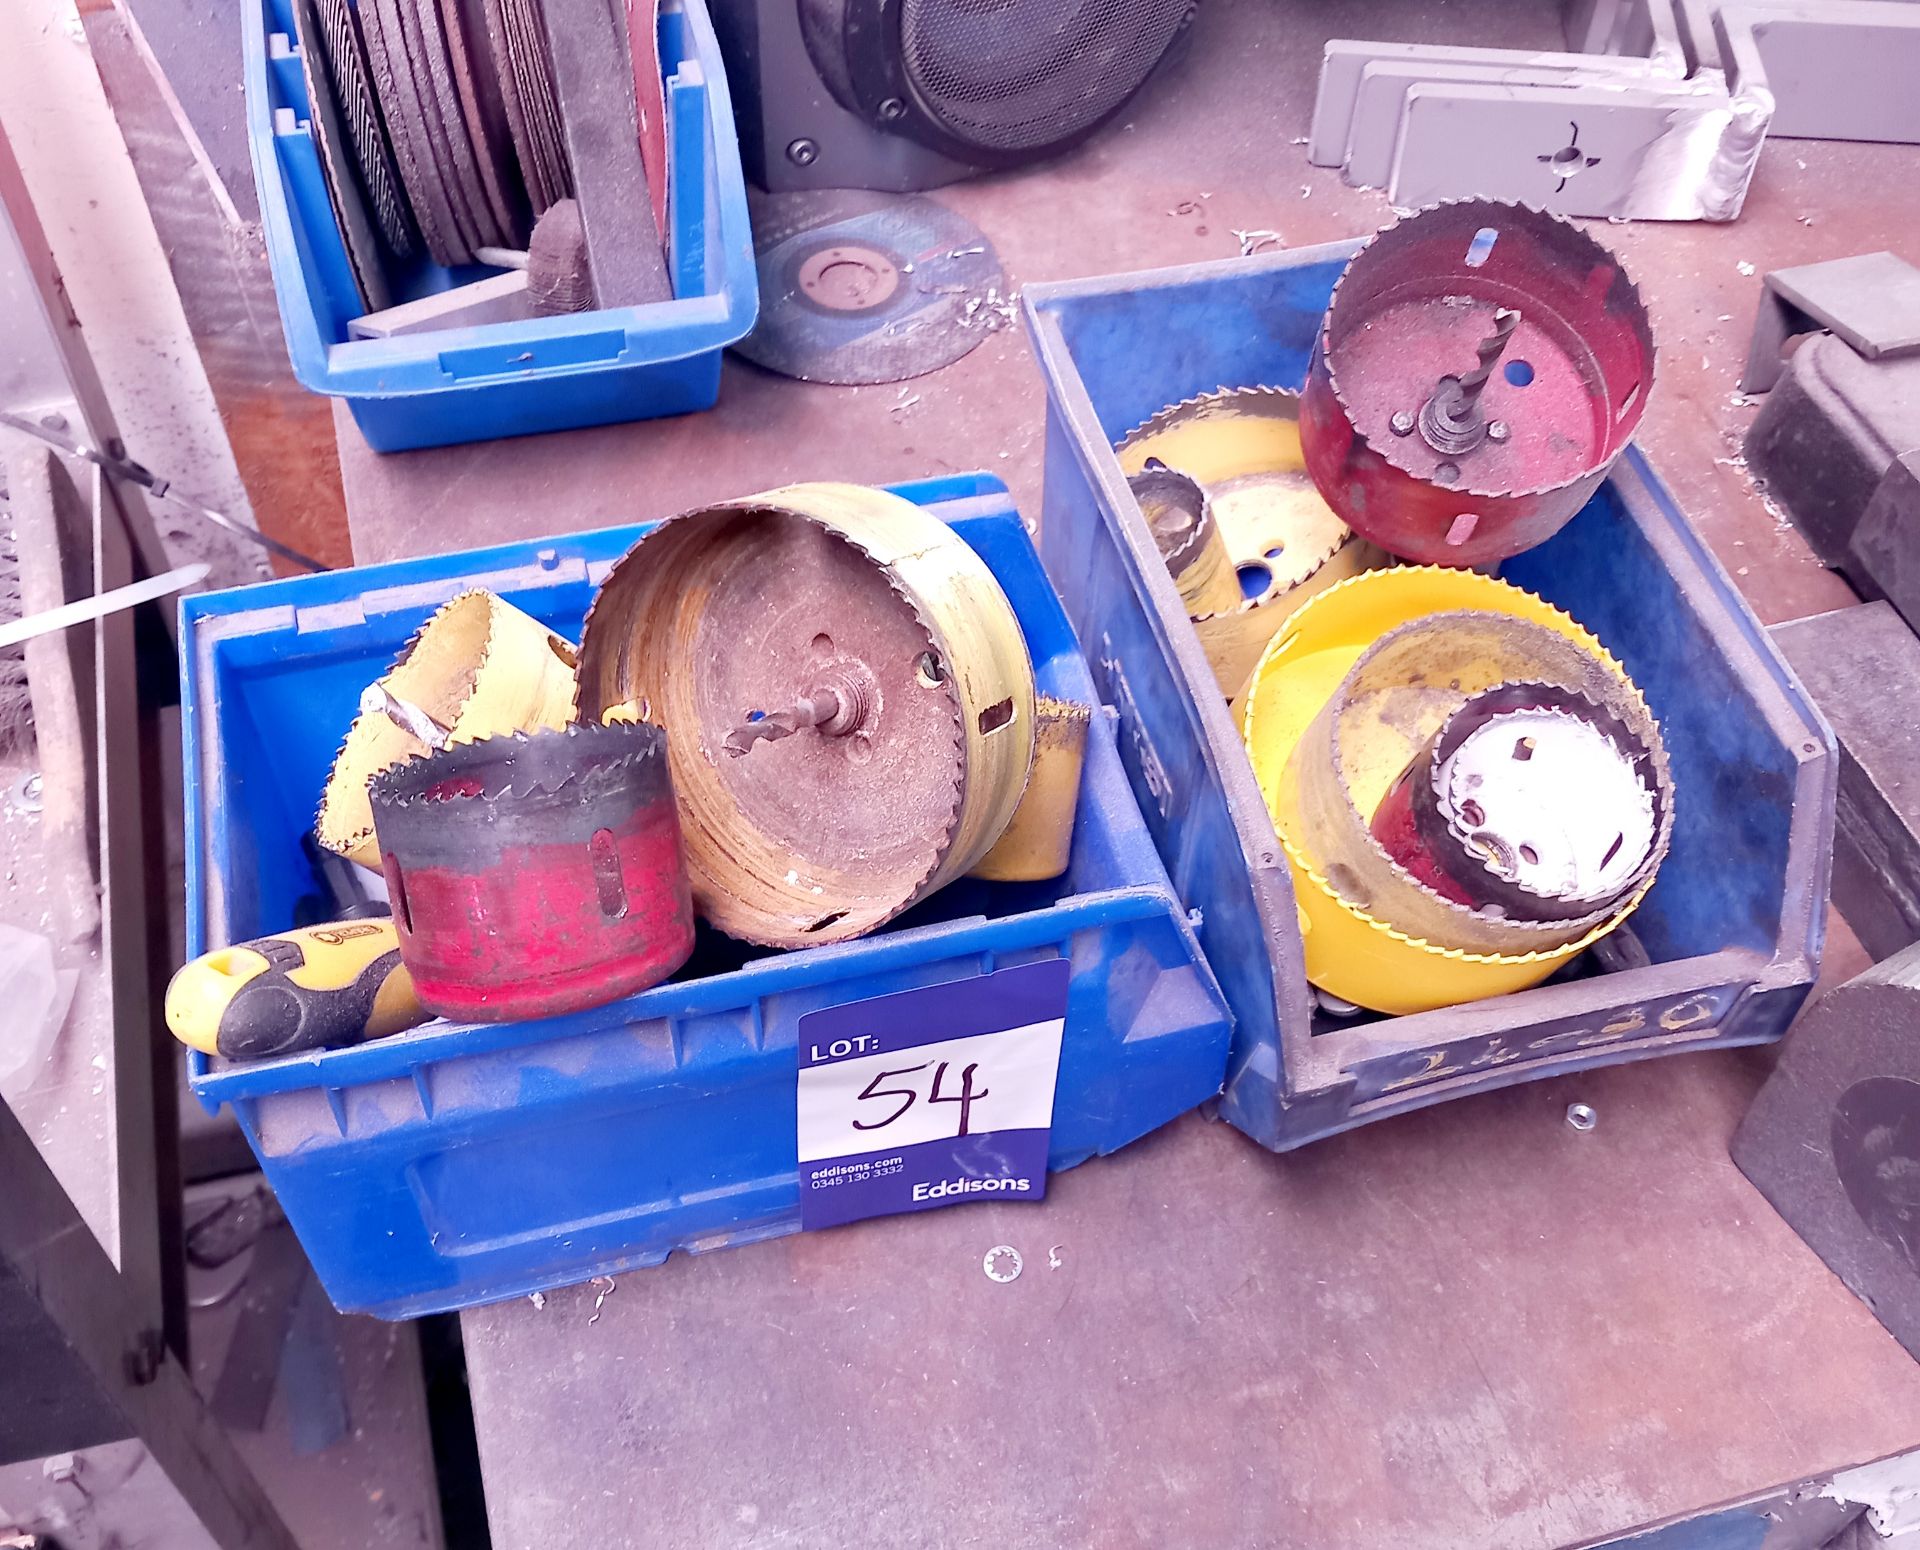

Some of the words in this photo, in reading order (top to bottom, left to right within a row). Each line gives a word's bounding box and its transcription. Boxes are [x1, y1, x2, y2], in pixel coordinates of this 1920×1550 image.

[811, 1034, 880, 1062] LOT:
[852, 1059, 989, 1137] 54
[811, 1157, 903, 1180] eddisons.com
[811, 1176, 844, 1190] 0345
[847, 1171, 870, 1183] 130
[873, 1164, 904, 1178] 3332
[912, 1177, 1030, 1202] Eddisons
